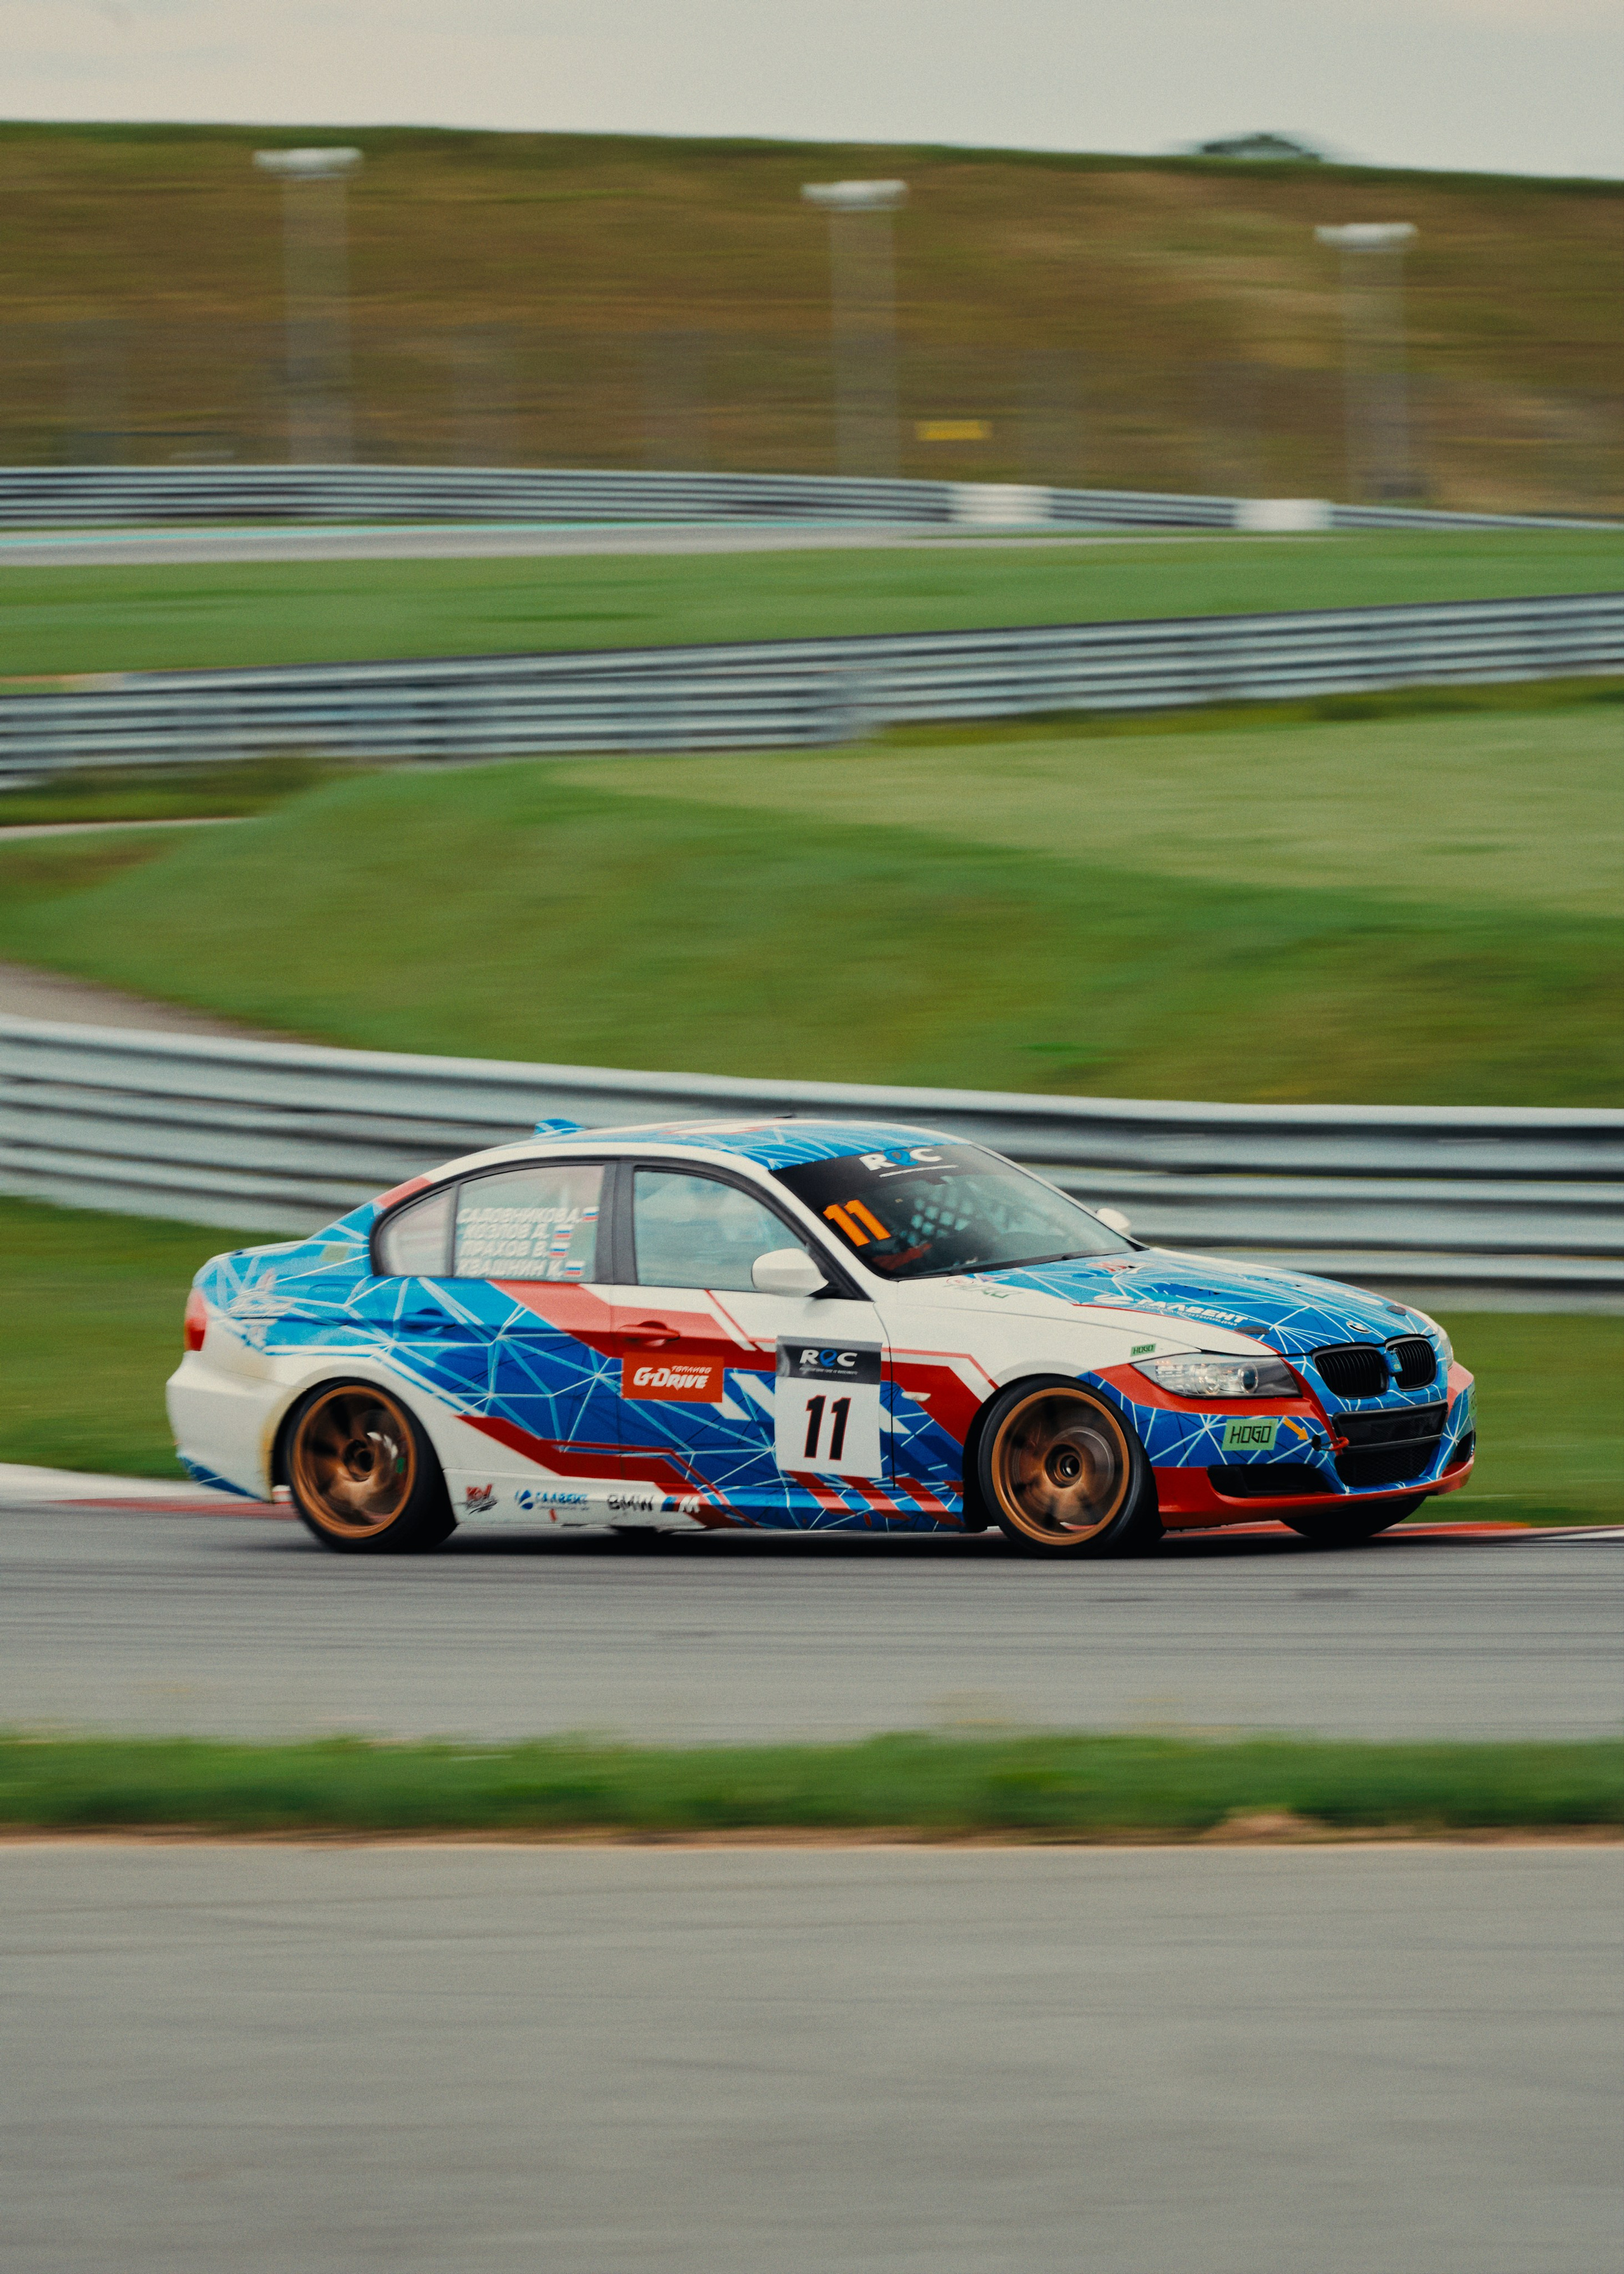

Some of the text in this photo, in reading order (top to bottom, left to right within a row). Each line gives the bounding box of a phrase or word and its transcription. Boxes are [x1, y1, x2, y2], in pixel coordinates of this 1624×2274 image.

[823, 1199, 891, 1247] 11
[1136, 1298, 1249, 1324] ГАЛВЕНТ
[1133, 1343, 1155, 1354] HOGO
[804, 1395, 852, 1461] 11
[1229, 1425, 1272, 1444] HOGO
[607, 1494, 654, 1512] BMW
